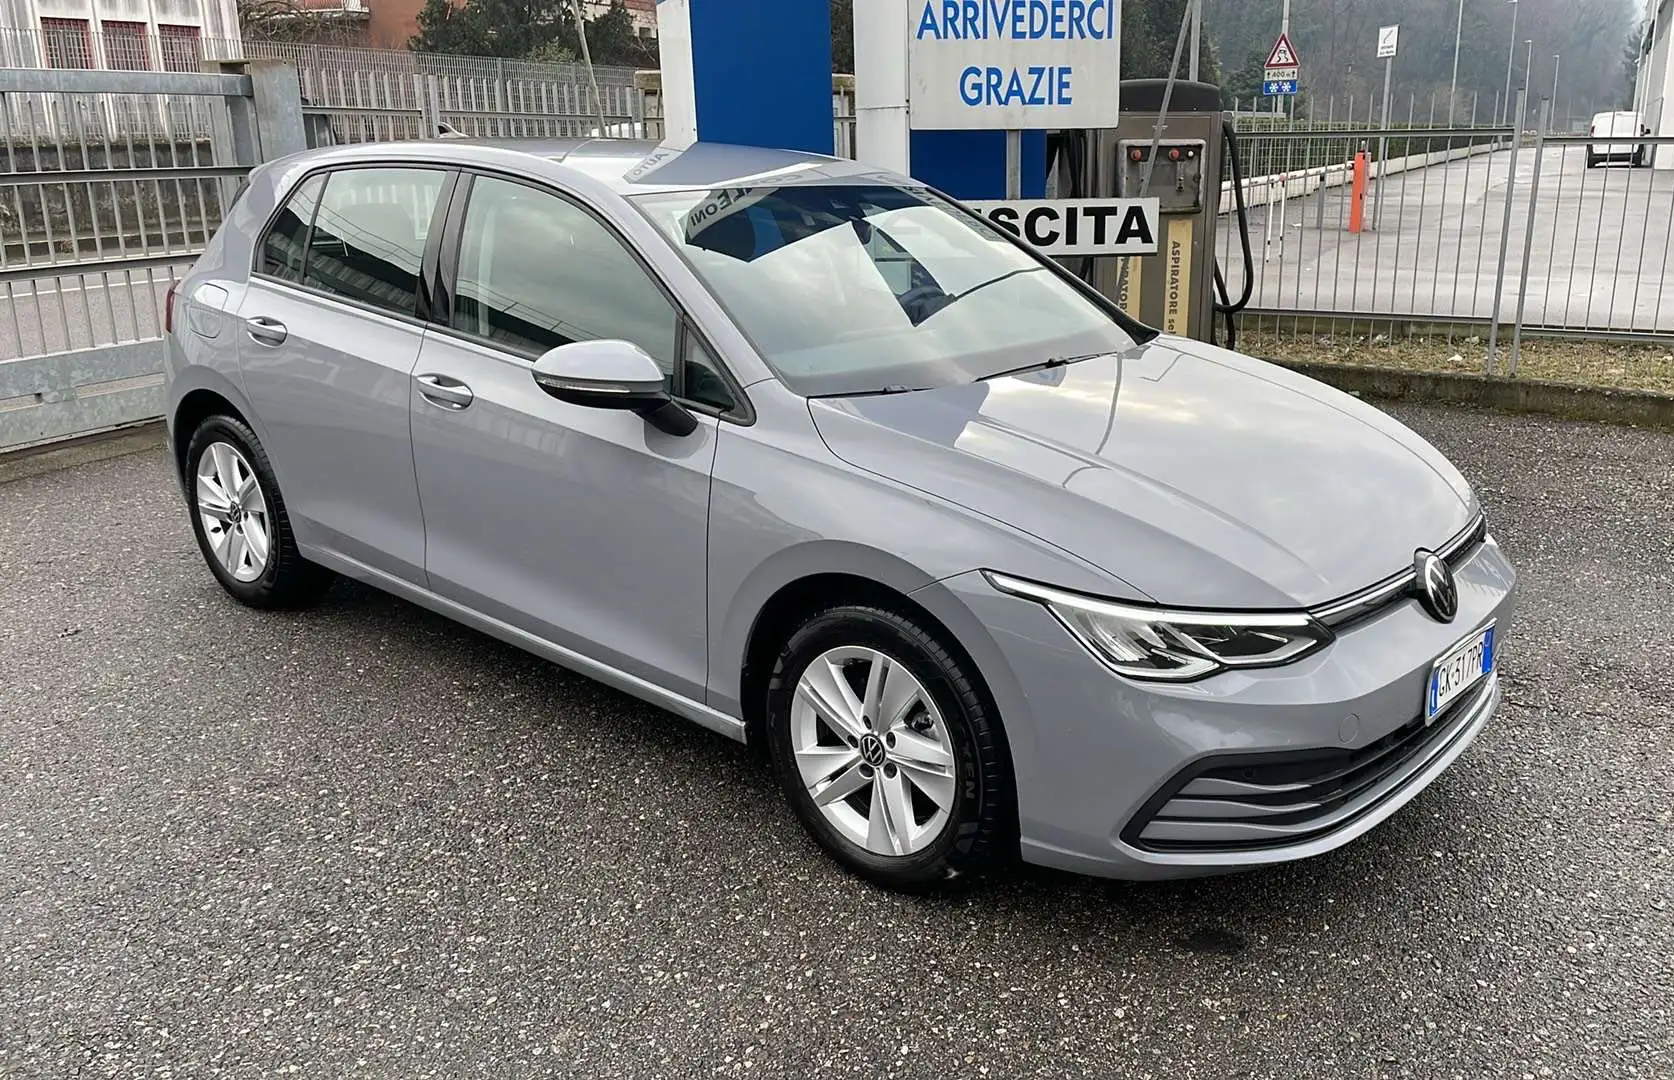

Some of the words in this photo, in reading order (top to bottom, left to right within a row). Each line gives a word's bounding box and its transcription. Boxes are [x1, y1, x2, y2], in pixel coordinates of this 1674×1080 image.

[916, 0, 1113, 40] ARRIVEDERCI
[959, 66, 1073, 106] GRAZIE
[972, 205, 1154, 247] SCITA
[1168, 240, 1181, 315] ASPIRATORE
